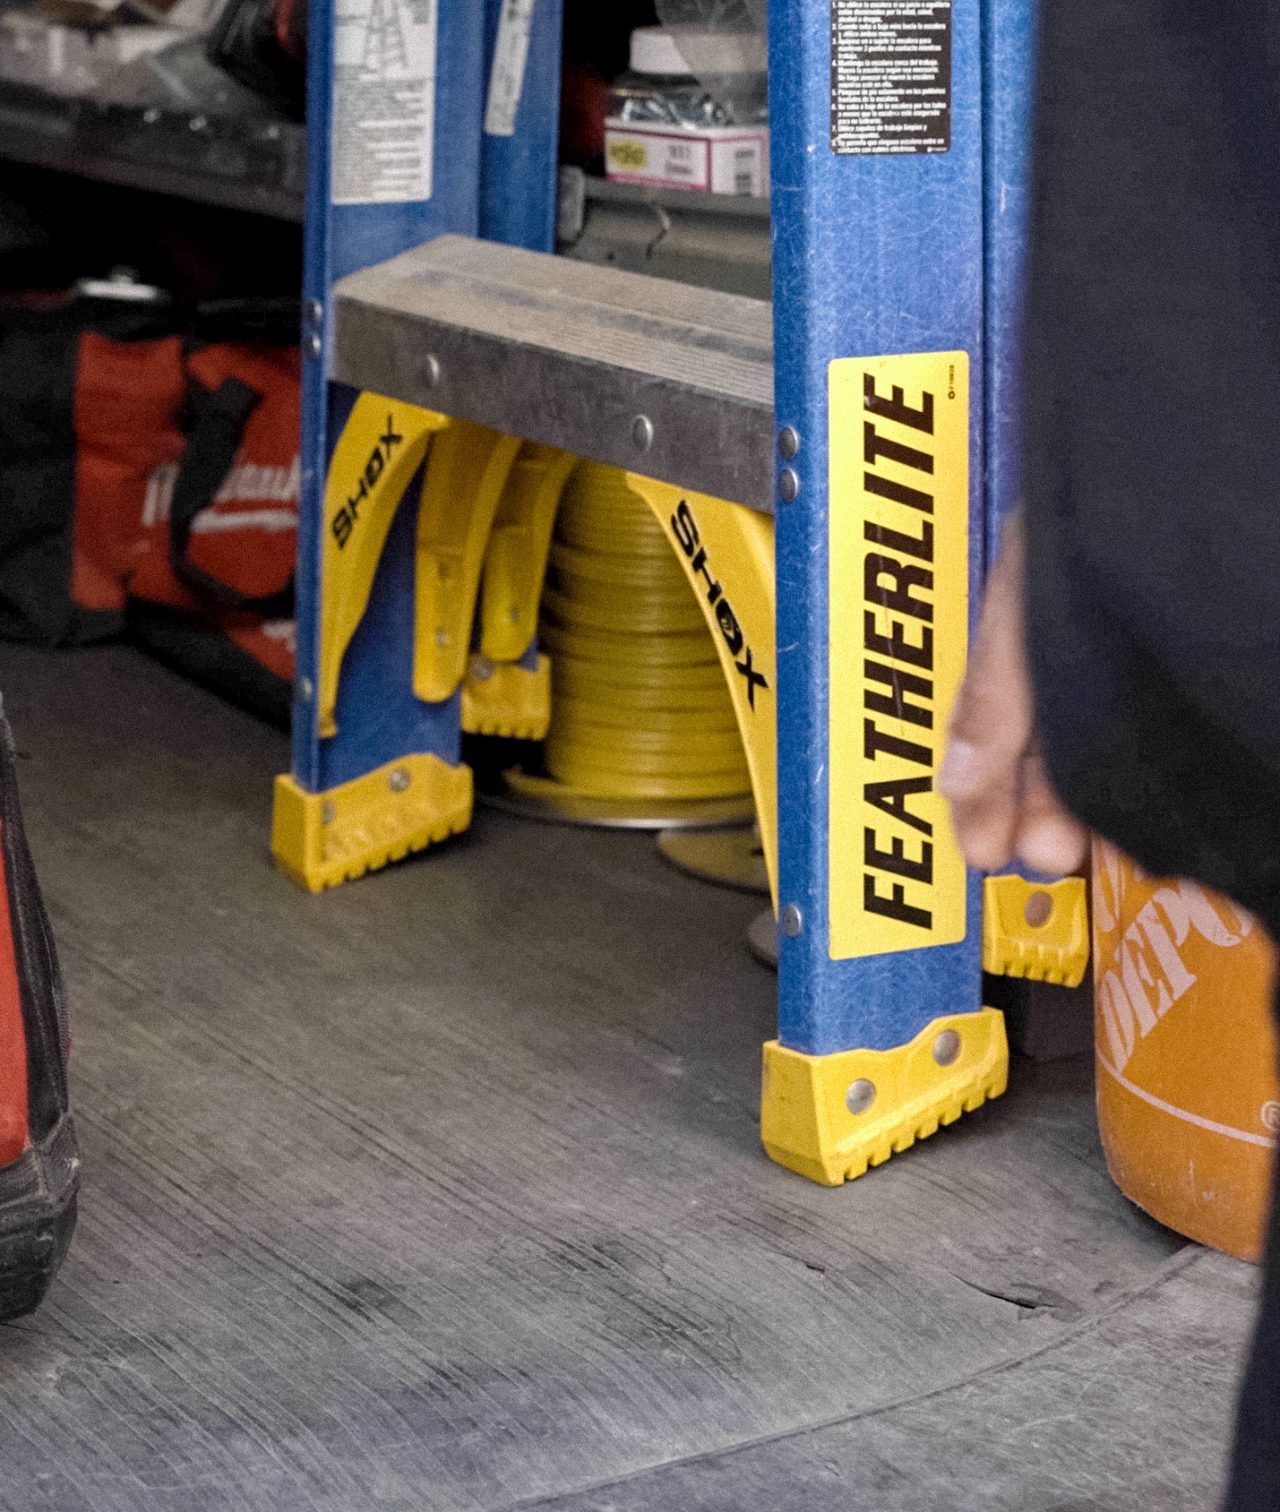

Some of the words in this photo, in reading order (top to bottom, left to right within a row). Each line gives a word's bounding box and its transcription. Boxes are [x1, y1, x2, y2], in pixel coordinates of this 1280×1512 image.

[332, 412, 402, 550] SHOX
[671, 500, 769, 712] SHOX
[863, 373, 934, 930] FEATHERLITE
